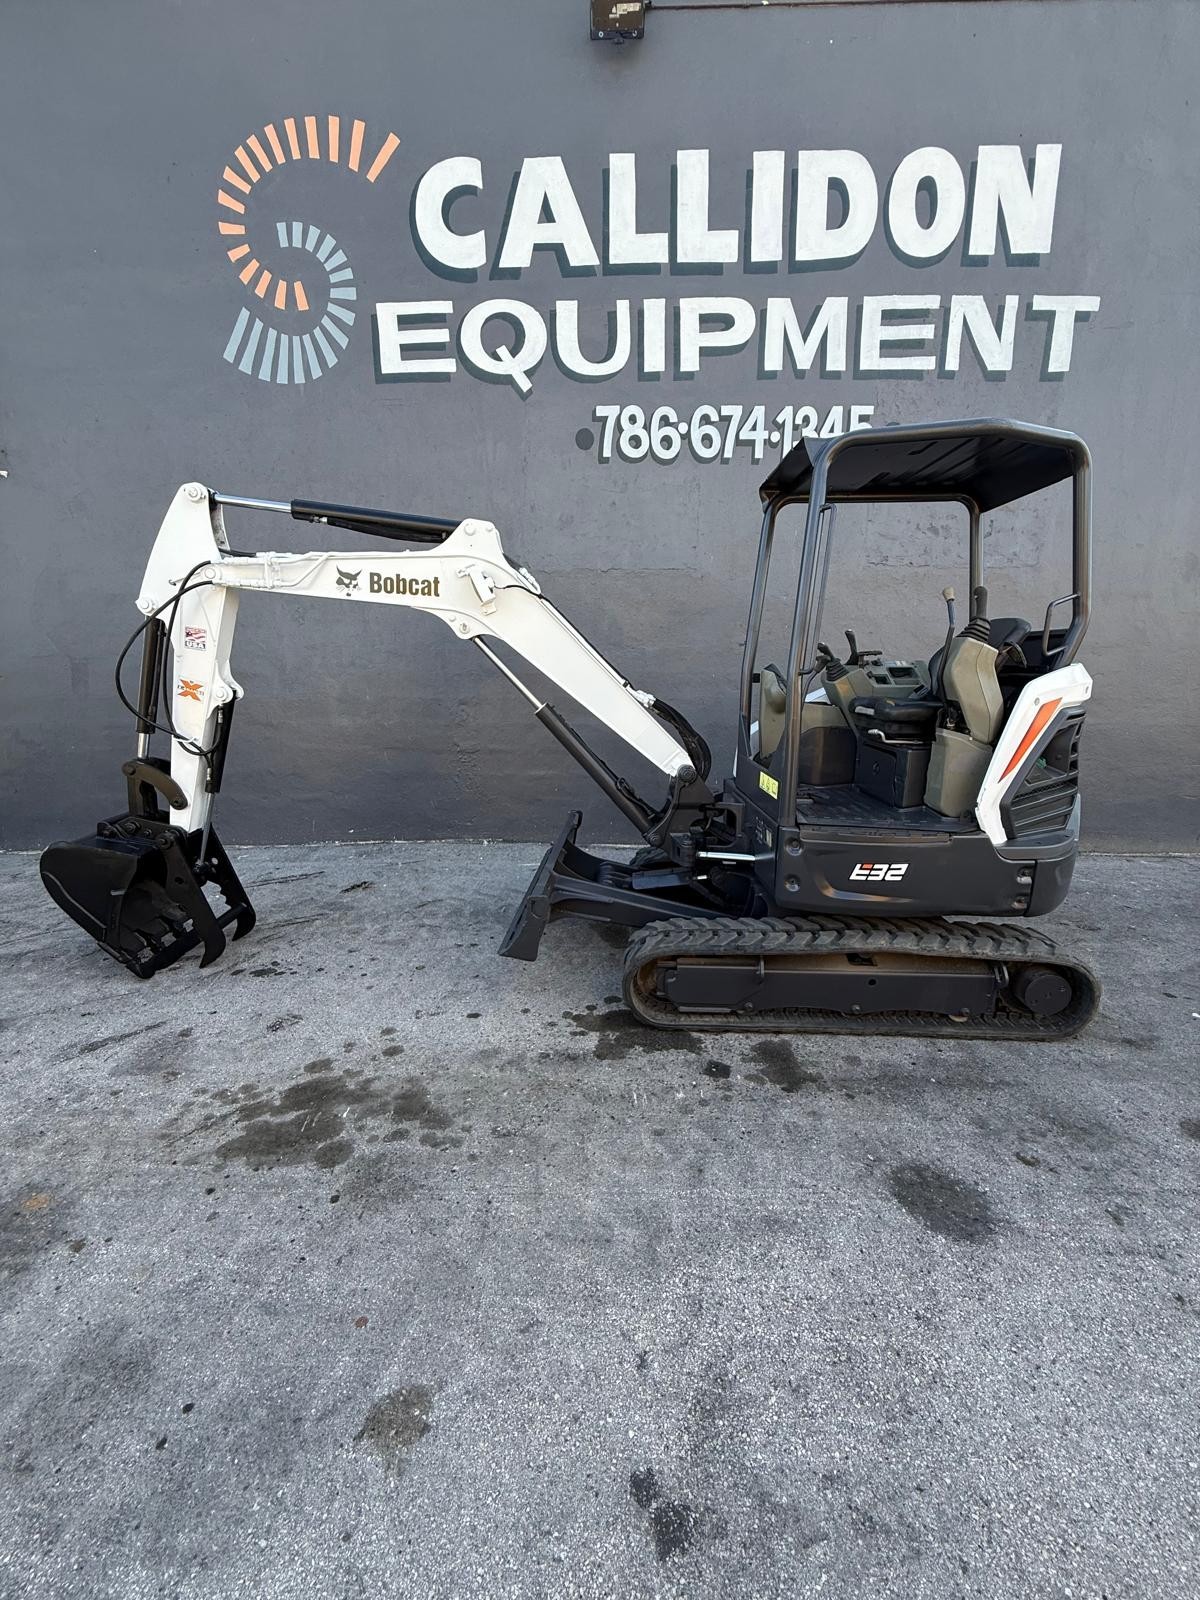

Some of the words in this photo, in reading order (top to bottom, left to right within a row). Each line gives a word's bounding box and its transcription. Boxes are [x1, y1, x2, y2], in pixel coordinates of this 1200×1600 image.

[415, 144, 1062, 270] CALLIDON
[375, 294, 1102, 393] EQUIPMENT
[369, 572, 440, 598] Bobcat
[849, 863, 909, 881] E32
